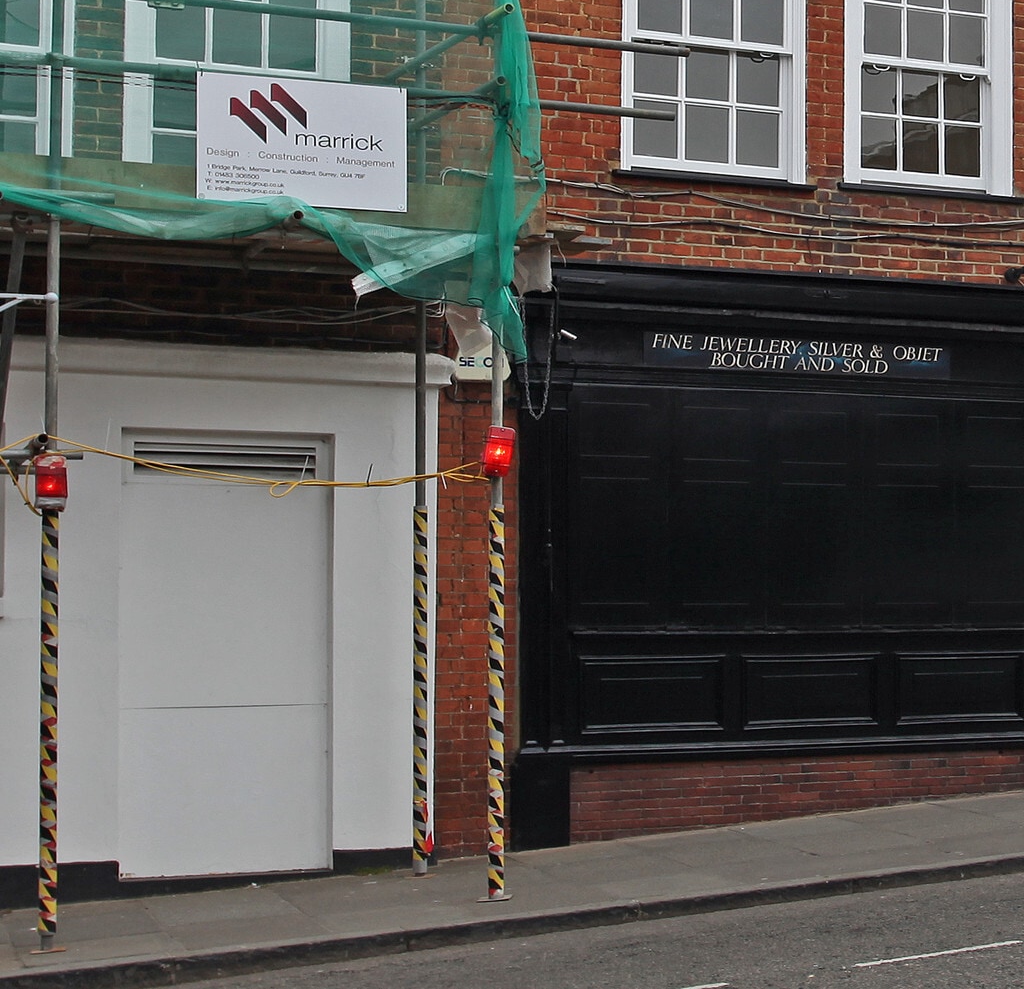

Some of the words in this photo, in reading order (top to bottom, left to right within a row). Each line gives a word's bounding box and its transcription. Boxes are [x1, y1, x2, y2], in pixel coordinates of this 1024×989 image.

[295, 133, 383, 152] marrick
[206, 147, 240, 159] Design
[258, 151, 319, 163] Construction
[336, 156, 396, 168] Management
[214, 179, 285, 189] www.marrickgroup.co.uk
[214, 186, 284, 195] info@marrickgroup.co.uk
[652, 333, 693, 350] FINE
[807, 341, 864, 358] SILVER
[869, 344, 883, 359] &
[893, 346, 944, 362] OBJET
[710, 352, 790, 370] BOUGHT
[794, 356, 835, 372] AND
[841, 358, 889, 374] SOLD
